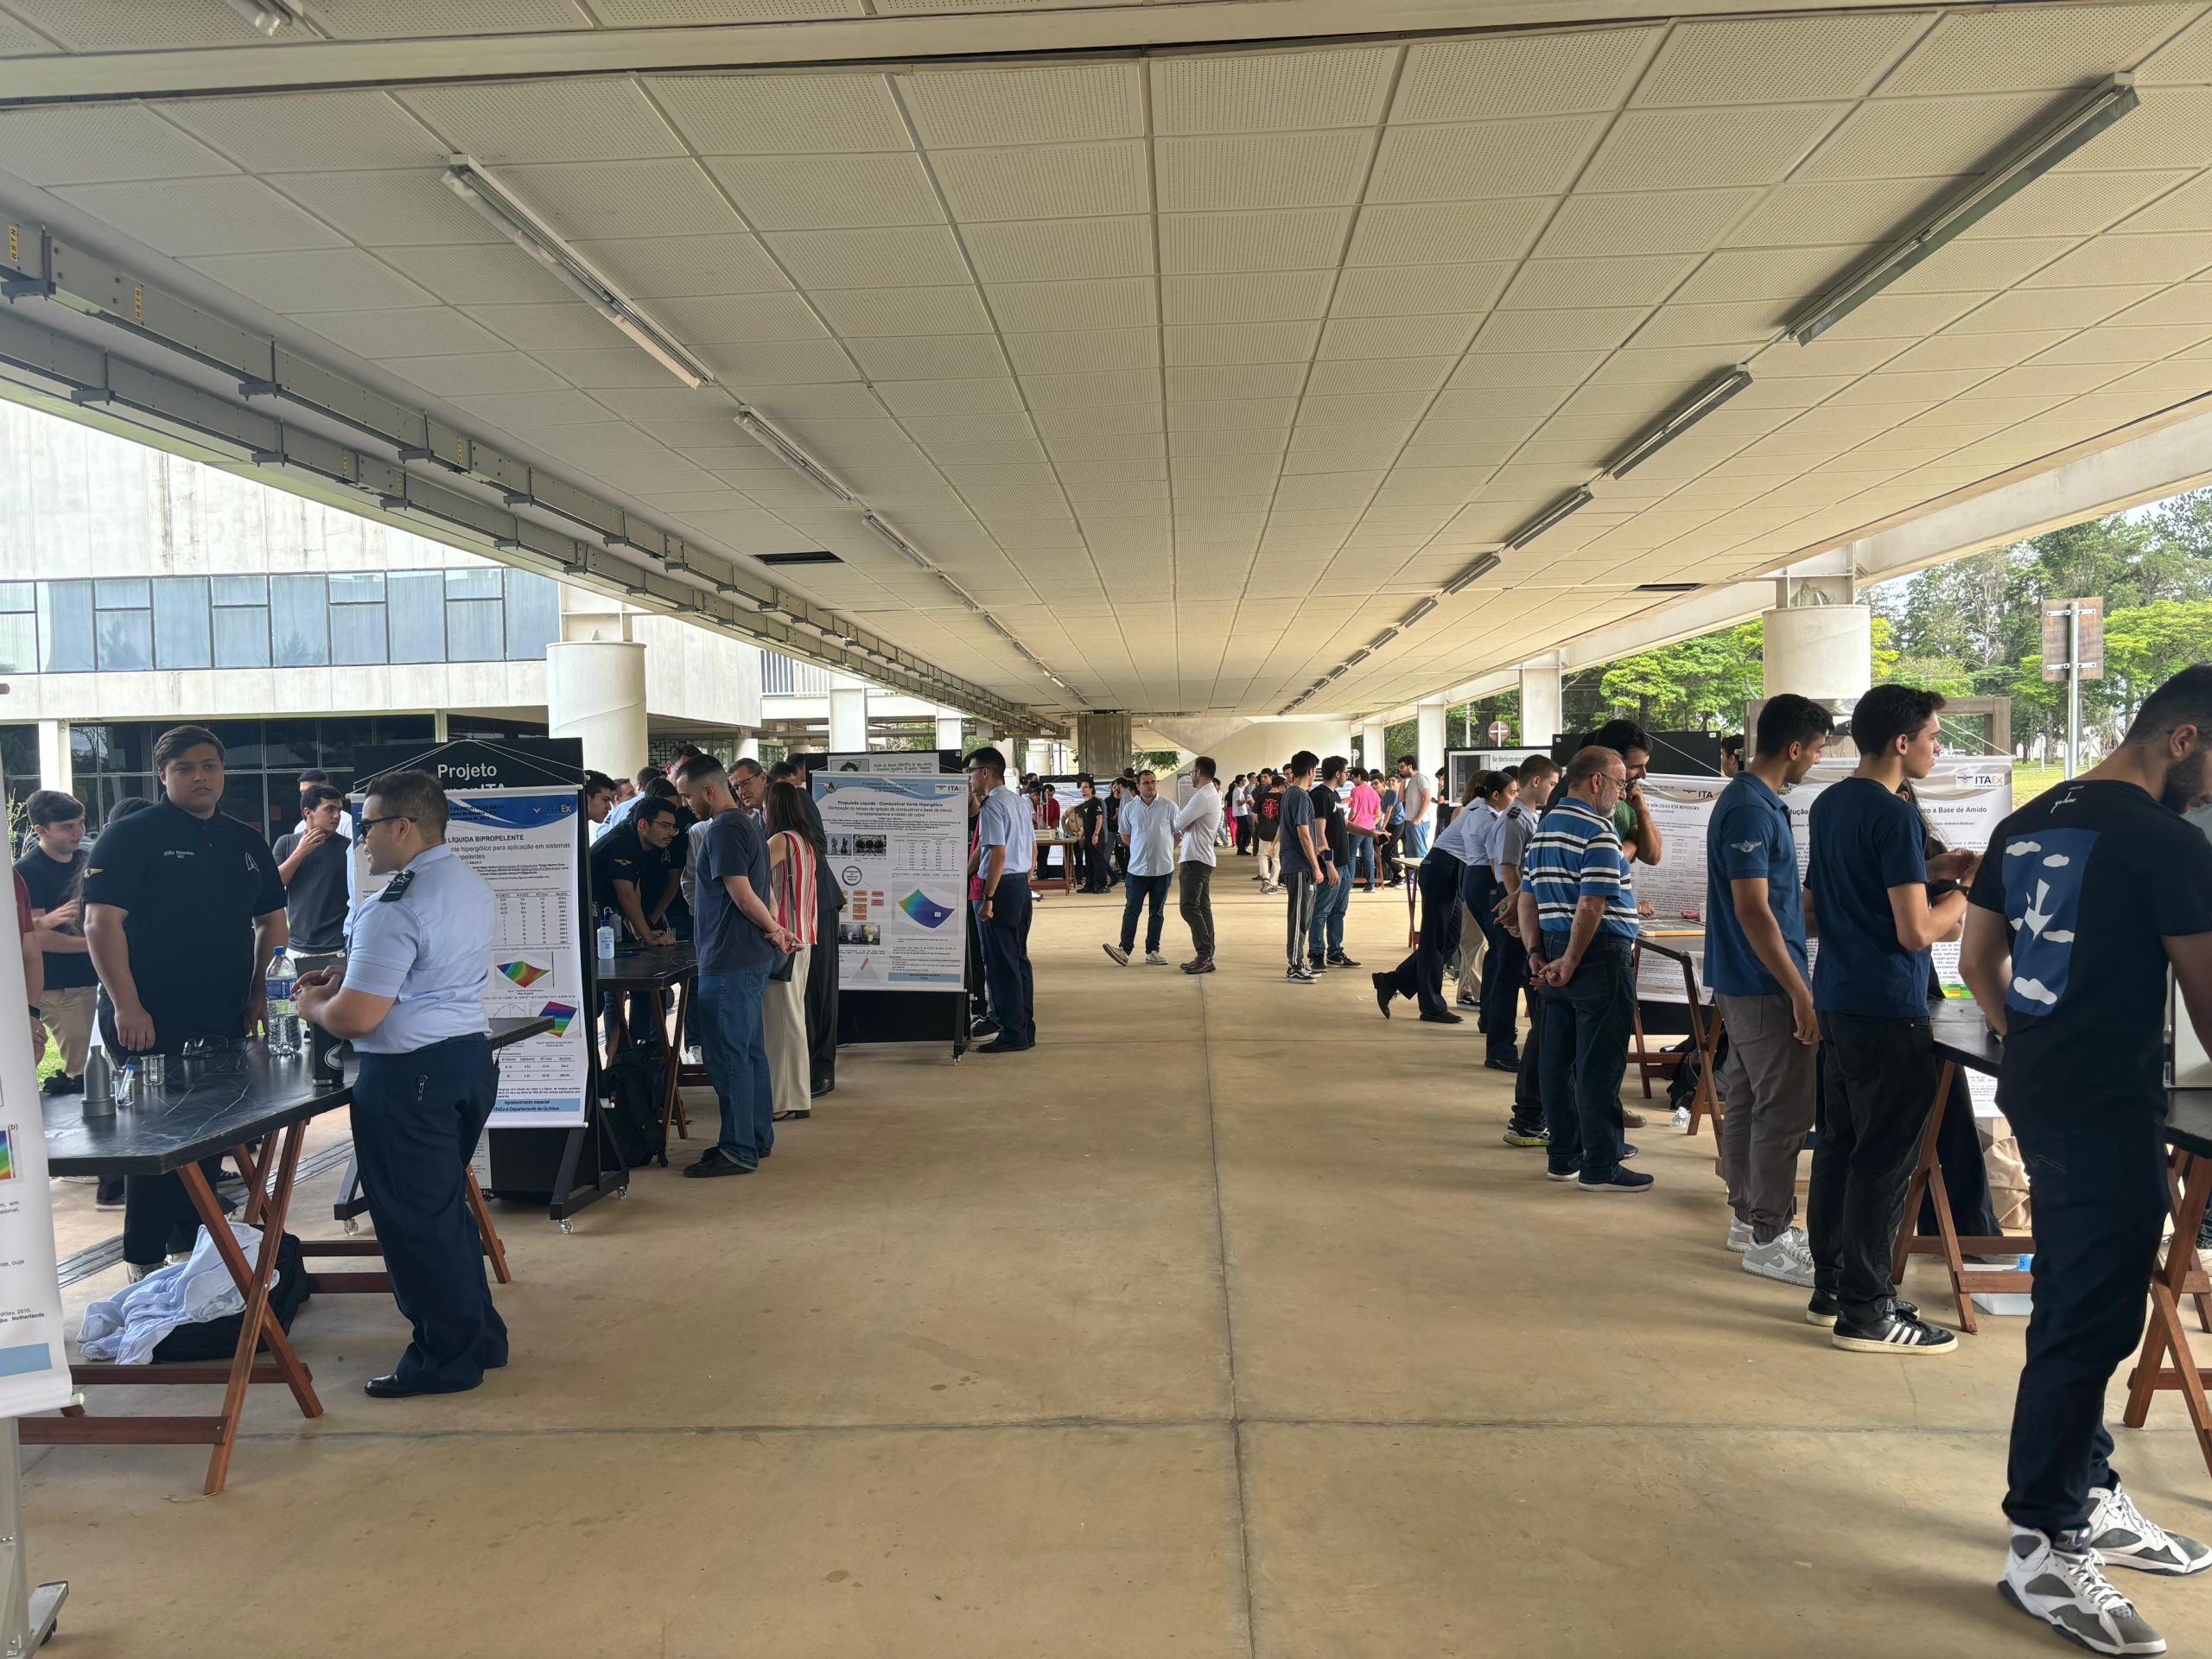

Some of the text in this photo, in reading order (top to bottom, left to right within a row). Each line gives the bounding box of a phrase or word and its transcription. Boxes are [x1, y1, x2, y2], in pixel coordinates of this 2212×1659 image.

[437, 763, 497, 780] Projeto
[1975, 776, 2003, 785] ITAEx
[448, 834, 524, 843] LÍQUIDA BIPROPELENTE
